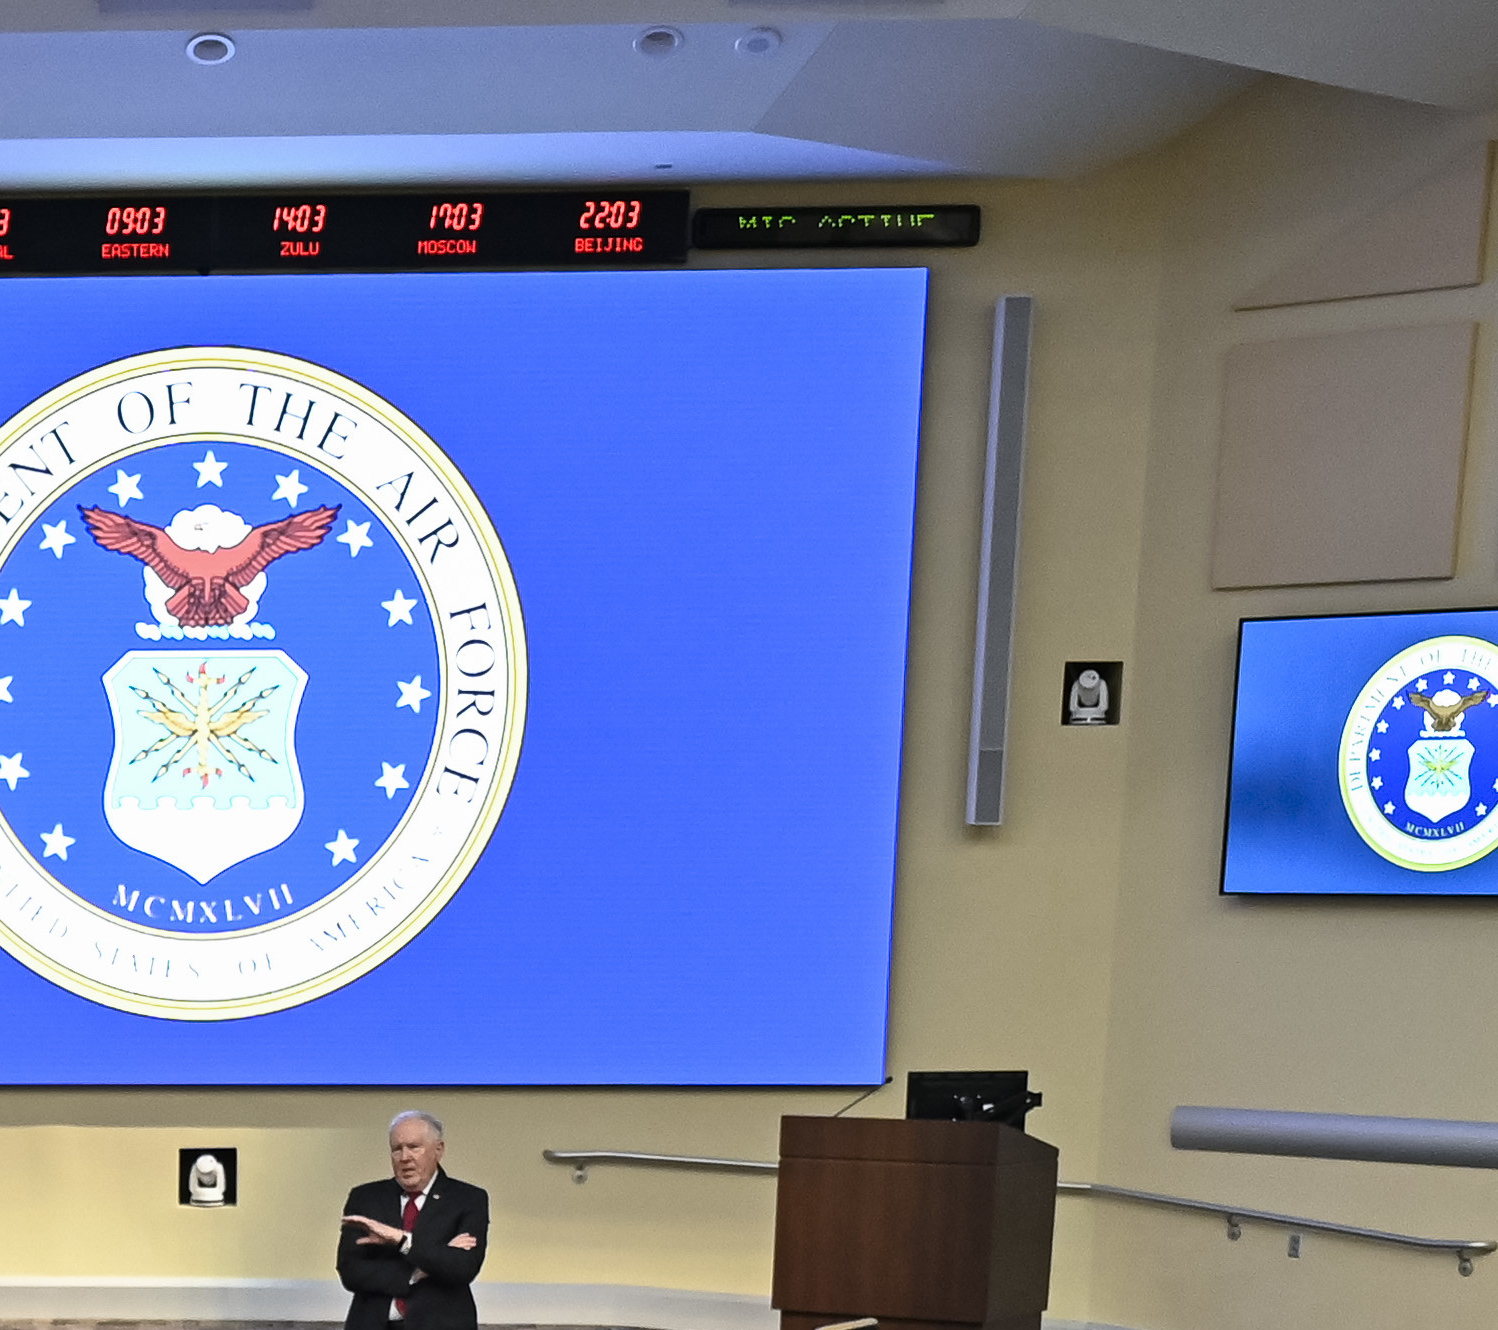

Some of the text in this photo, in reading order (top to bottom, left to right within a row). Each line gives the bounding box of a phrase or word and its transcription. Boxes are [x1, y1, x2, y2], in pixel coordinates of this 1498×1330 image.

[101, 242, 170, 259] EASTERN
[280, 241, 321, 257] ZULU
[417, 239, 477, 255] MOSCOW
[574, 236, 644, 254] BEIJING
[116, 381, 195, 435] OF
[239, 382, 358, 460] THE
[375, 470, 460, 565] AIR
[435, 601, 496, 805] FORCE
[1406, 821, 1466, 838] MCMXLVII
[111, 882, 295, 926] MCMXLVII
